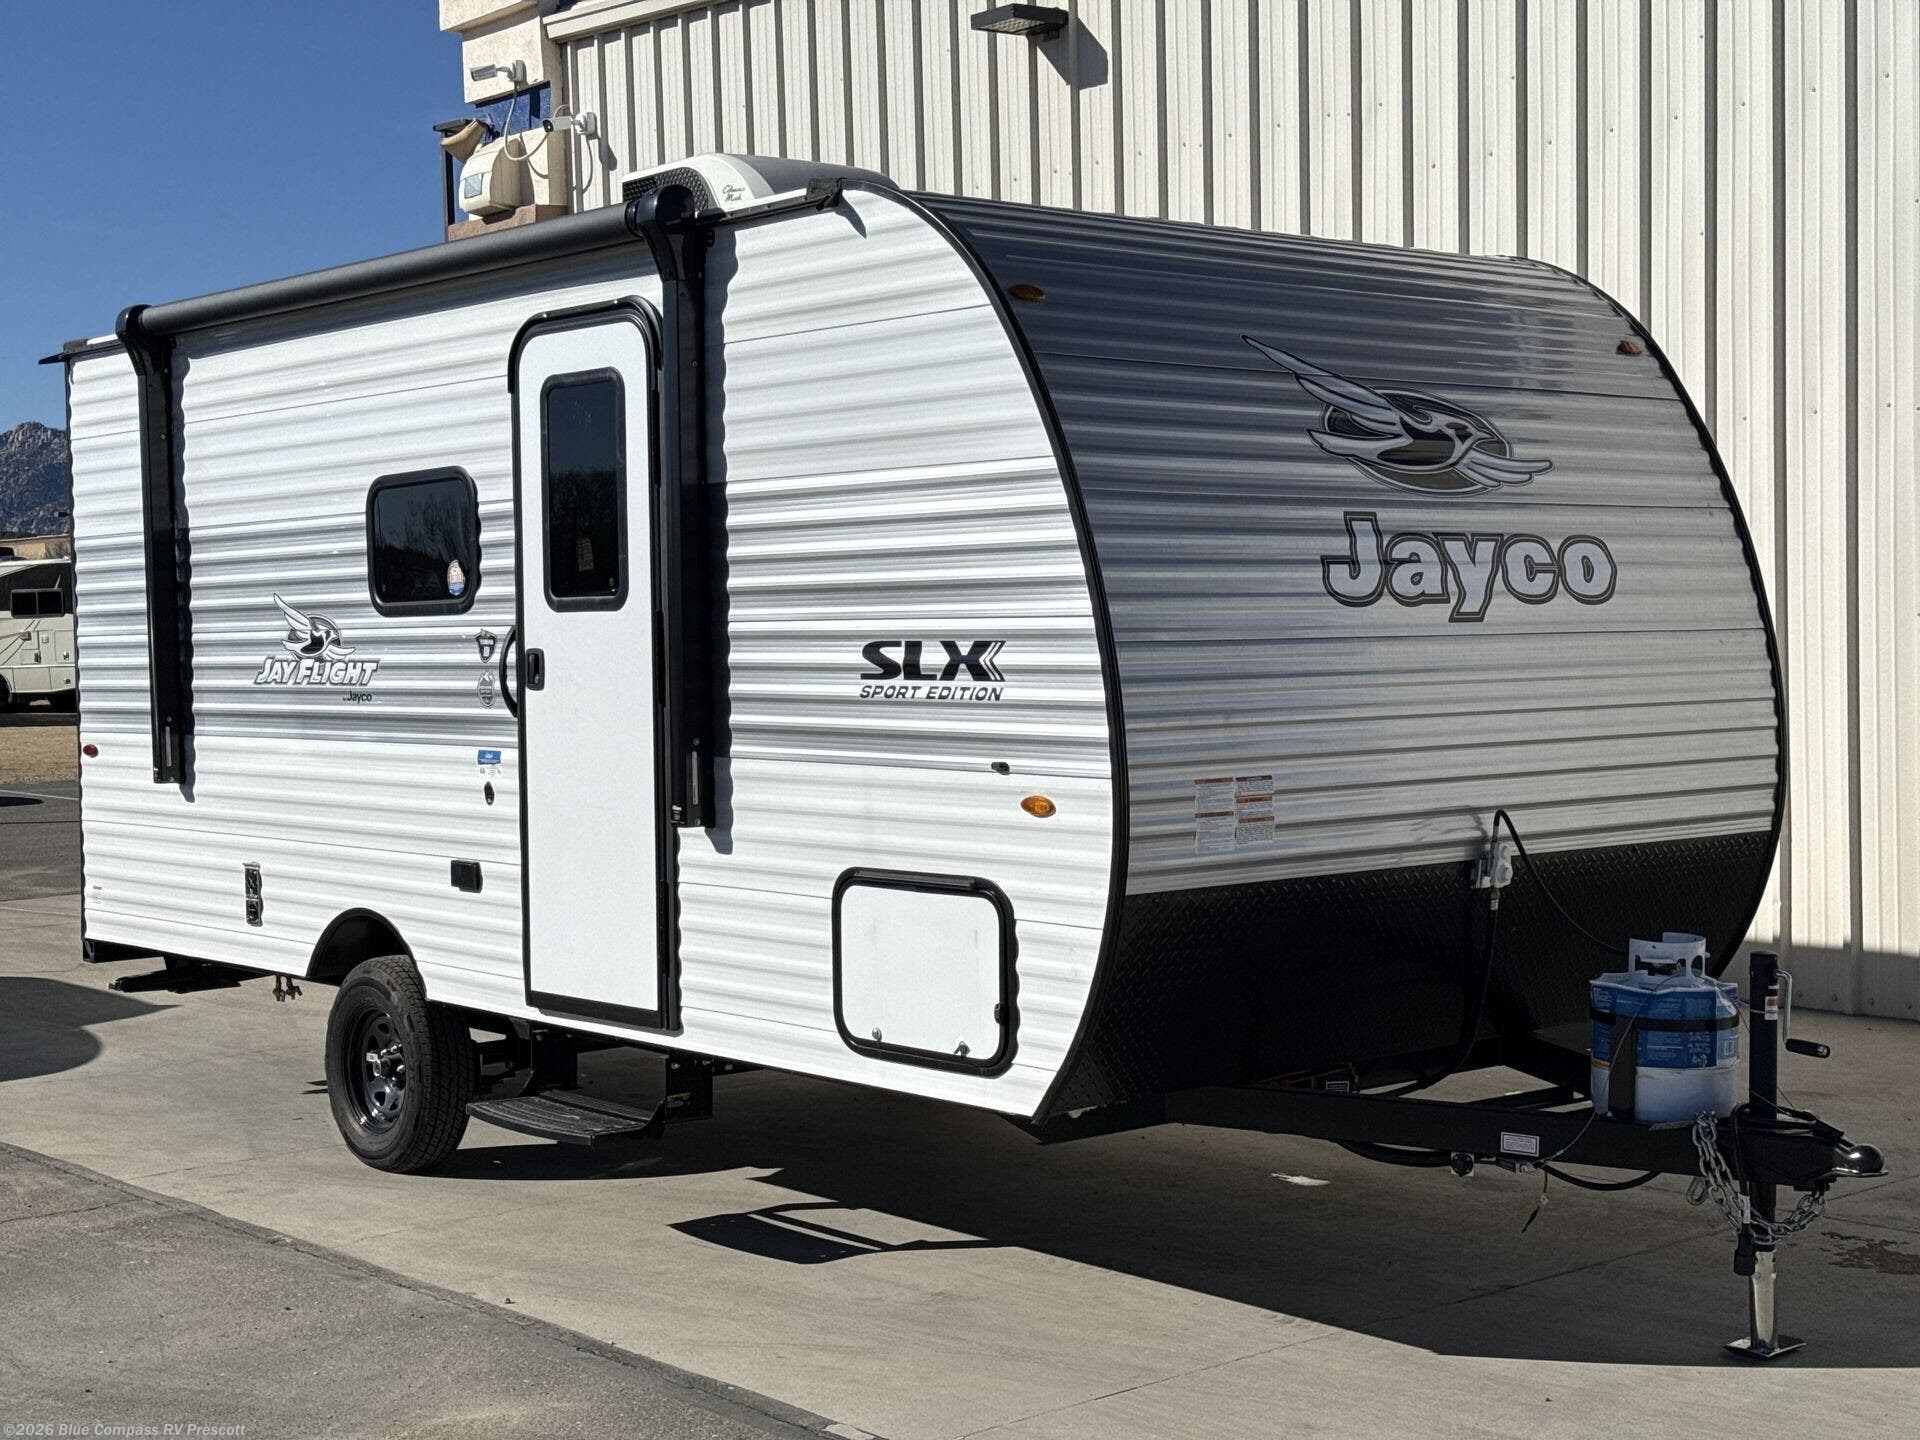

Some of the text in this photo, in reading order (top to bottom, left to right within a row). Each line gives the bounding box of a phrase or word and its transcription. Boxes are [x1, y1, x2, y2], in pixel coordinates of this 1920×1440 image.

[1321, 511, 1618, 623] Jayco
[254, 657, 381, 686] JAY FLIGHT
[860, 640, 1006, 682] SLX
[347, 690, 372, 704] Jayco
[860, 685, 1004, 701] SPORT EDITION
